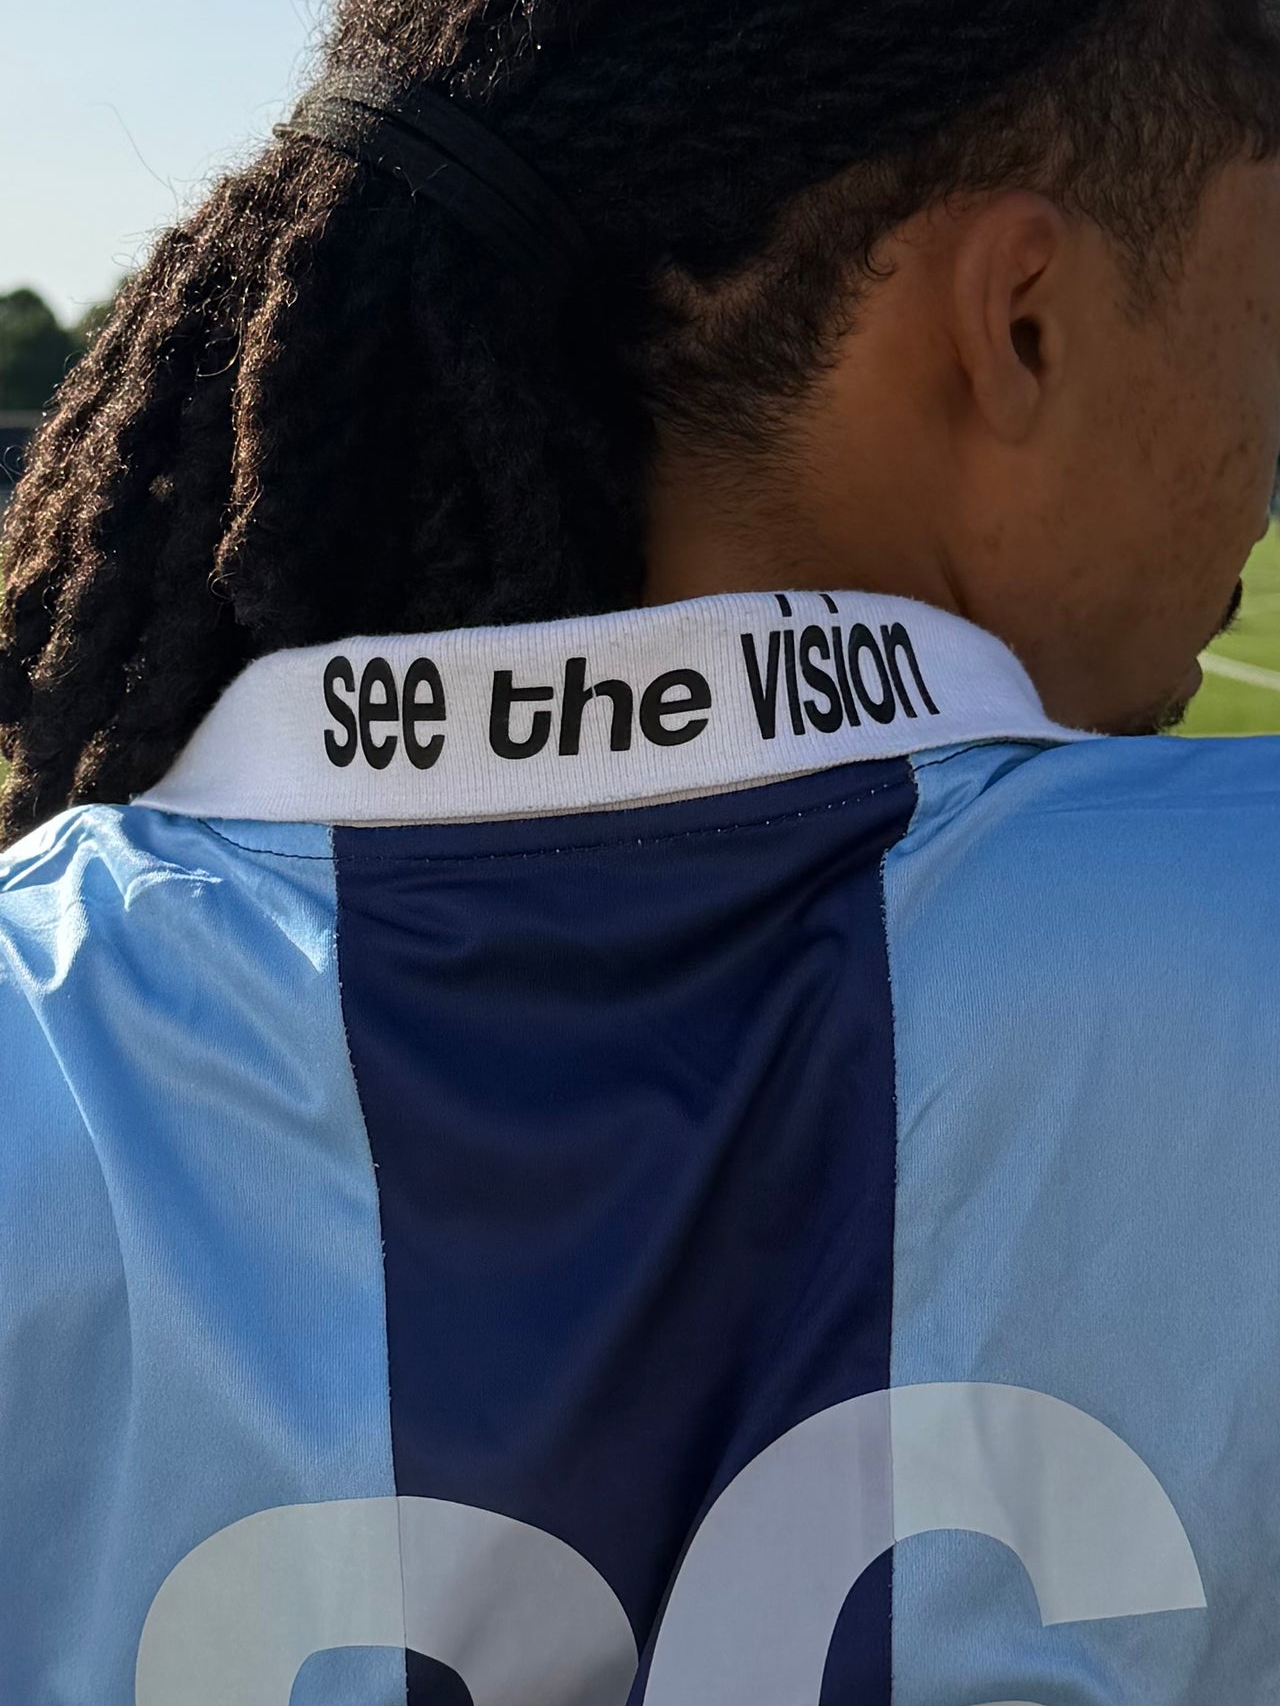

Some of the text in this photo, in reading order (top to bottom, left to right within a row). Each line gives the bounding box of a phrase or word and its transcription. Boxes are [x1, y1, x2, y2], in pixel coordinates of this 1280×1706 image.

[323, 593, 941, 771] see the vision
